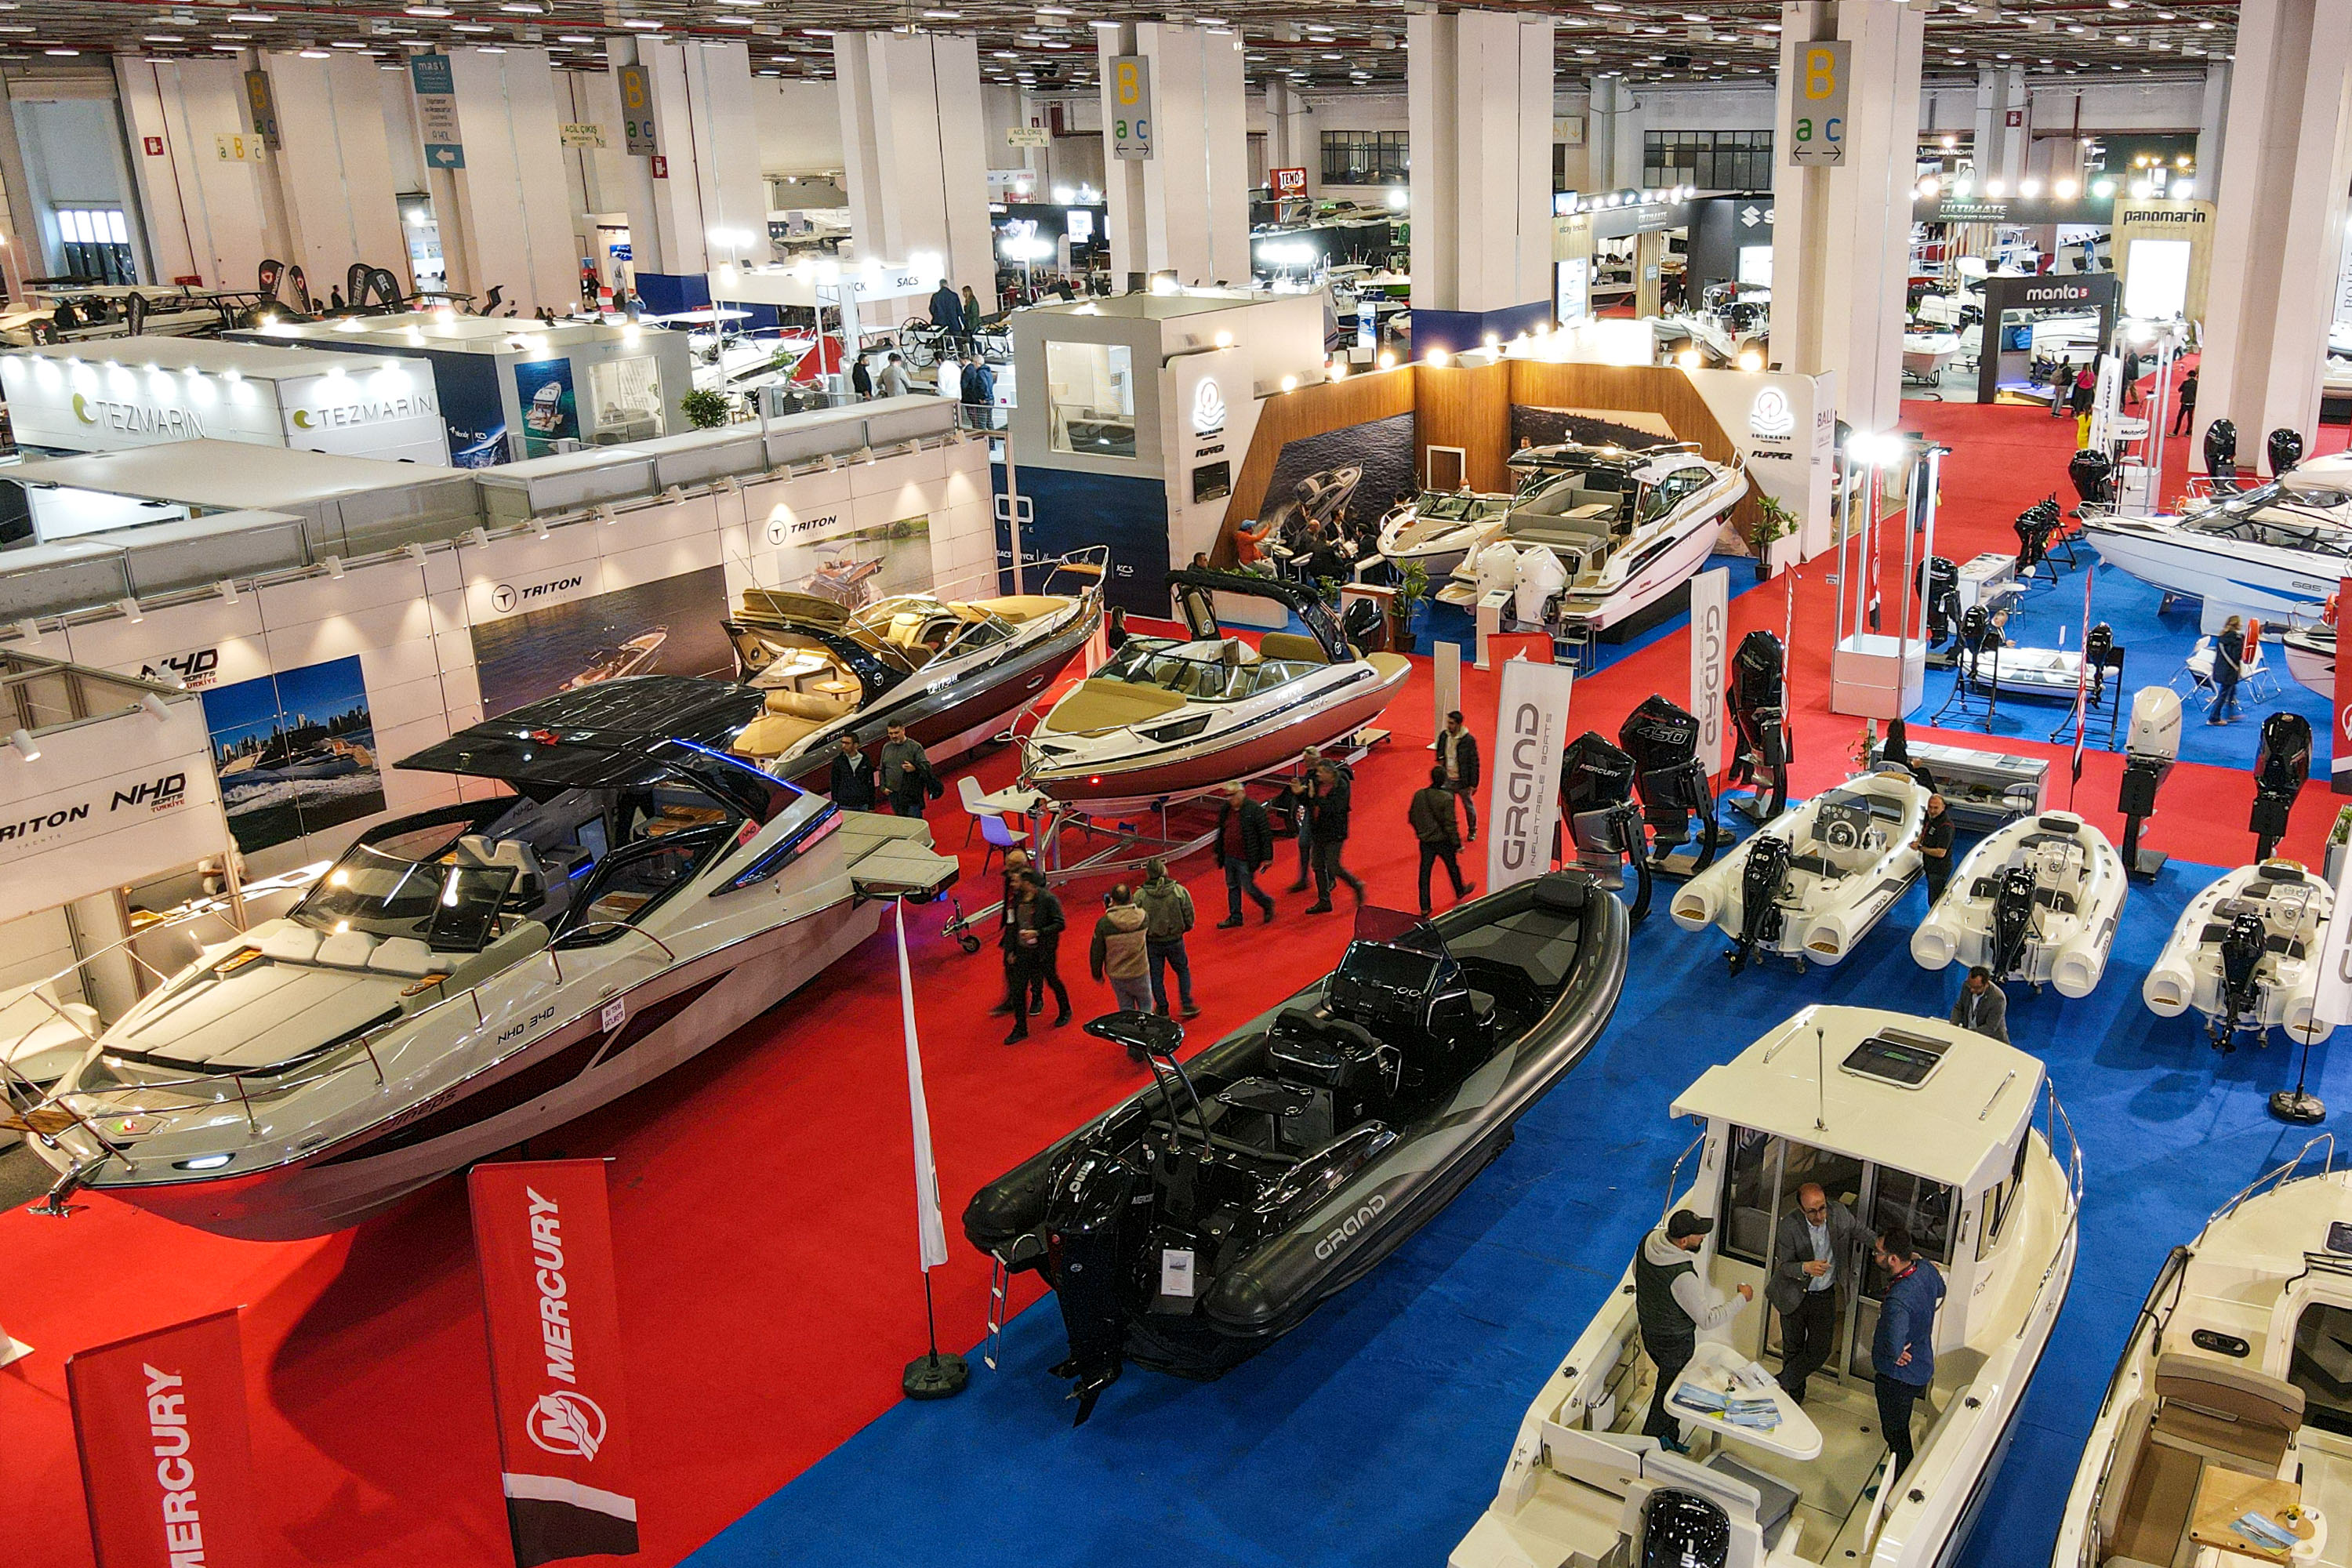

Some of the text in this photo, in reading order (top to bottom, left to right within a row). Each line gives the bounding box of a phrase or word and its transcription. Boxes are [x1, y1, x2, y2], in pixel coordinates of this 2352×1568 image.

[1117, 63, 1139, 105] B
[1805, 49, 1835, 100] B
[625, 71, 644, 108] B
[627, 121, 653, 138] a c
[1116, 119, 1147, 139] a c
[1796, 118, 1841, 142] a c
[220, 147, 227, 158] a
[234, 137, 245, 159] B
[1940, 204, 2007, 215] ULTIMATE
[1751, 450, 1793, 460] FLIPPER
[790, 515, 837, 533] TRITON
[1004, 524, 1034, 534] LFE
[521, 575, 582, 599] TRITON
[2292, 582, 2321, 592] 685
[1637, 727, 1691, 745] 450
[1580, 763, 1622, 779] MERCURY
[1531, 713, 1552, 866] INFLATABLE BOATS
[0, 772, 187, 844] RITON NHD
[497, 1023, 524, 1045] NHD
[1315, 1194, 1386, 1260] GRAND
[526, 1185, 576, 1385] MERCURY
